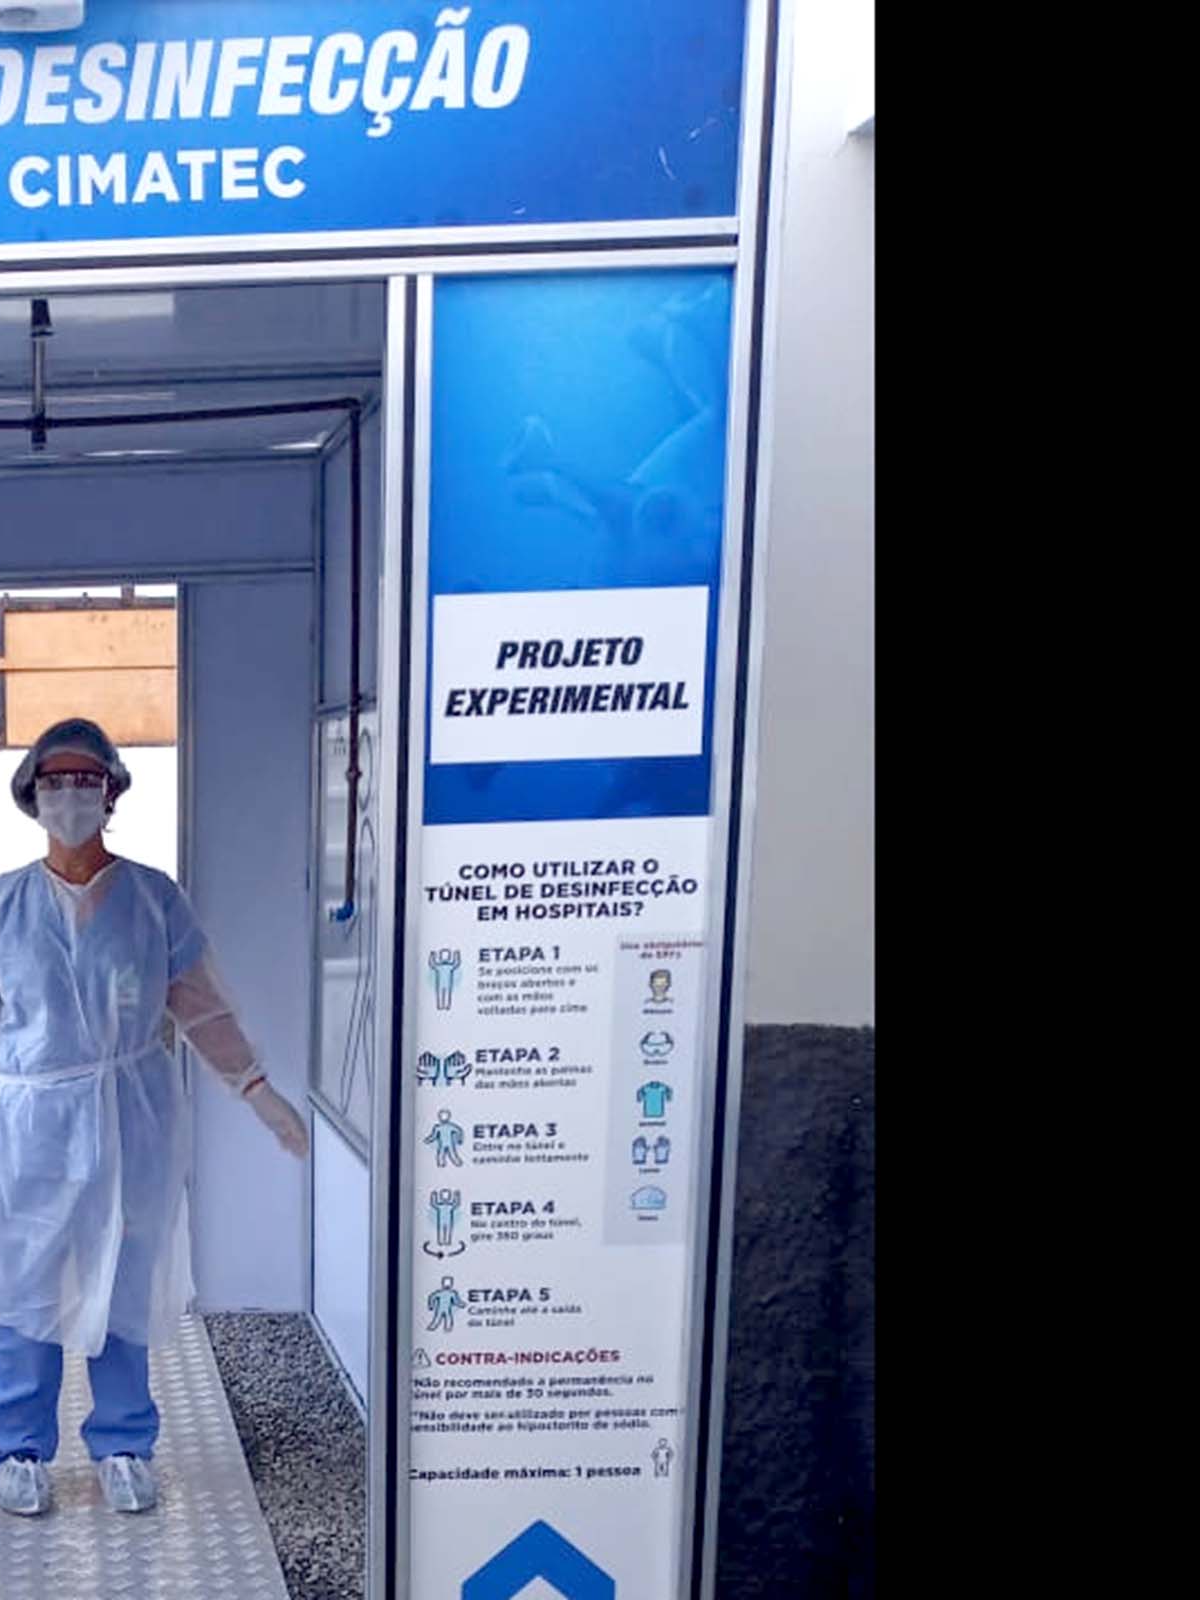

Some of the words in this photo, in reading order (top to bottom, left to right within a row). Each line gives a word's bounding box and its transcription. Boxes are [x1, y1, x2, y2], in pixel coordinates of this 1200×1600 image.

[8, 146, 306, 207] CIMATEC
[496, 636, 644, 670] PROJETO
[444, 682, 689, 718] EXPERIMENTAL
[458, 862, 525, 880] COMO
[532, 860, 635, 878] UTILIZAR
[642, 859, 659, 875] O
[424, 882, 497, 902] TÚNEL
[503, 883, 533, 900] DE
[540, 875, 698, 899] DESINFECÇÃO
[476, 905, 508, 922] EM
[515, 901, 645, 920] HOSPITAIS?
[478, 946, 546, 962] ETAPA
[552, 945, 560, 960] 1
[475, 1047, 541, 1063] ETAPA
[548, 1046, 561, 1061] 2
[472, 1122, 539, 1139] ETAPA
[545, 1122, 558, 1137] 3
[470, 1200, 537, 1216] ETAPA
[542, 1199, 555, 1214] 4
[467, 1288, 532, 1302] ETAPA
[539, 1287, 551, 1301] 5
[435, 1348, 620, 1365] CONTRA-INDICAÇÕES
[444, 1376, 534, 1388] recomendado
[411, 1388, 442, 1400] únel
[445, 1390, 469, 1401] por
[471, 1389, 502, 1399] mais
[505, 1388, 522, 1399] de
[503, 1465, 570, 1480] máxima:
[575, 1465, 582, 1478] 1
[586, 1465, 642, 1479] pessoa
